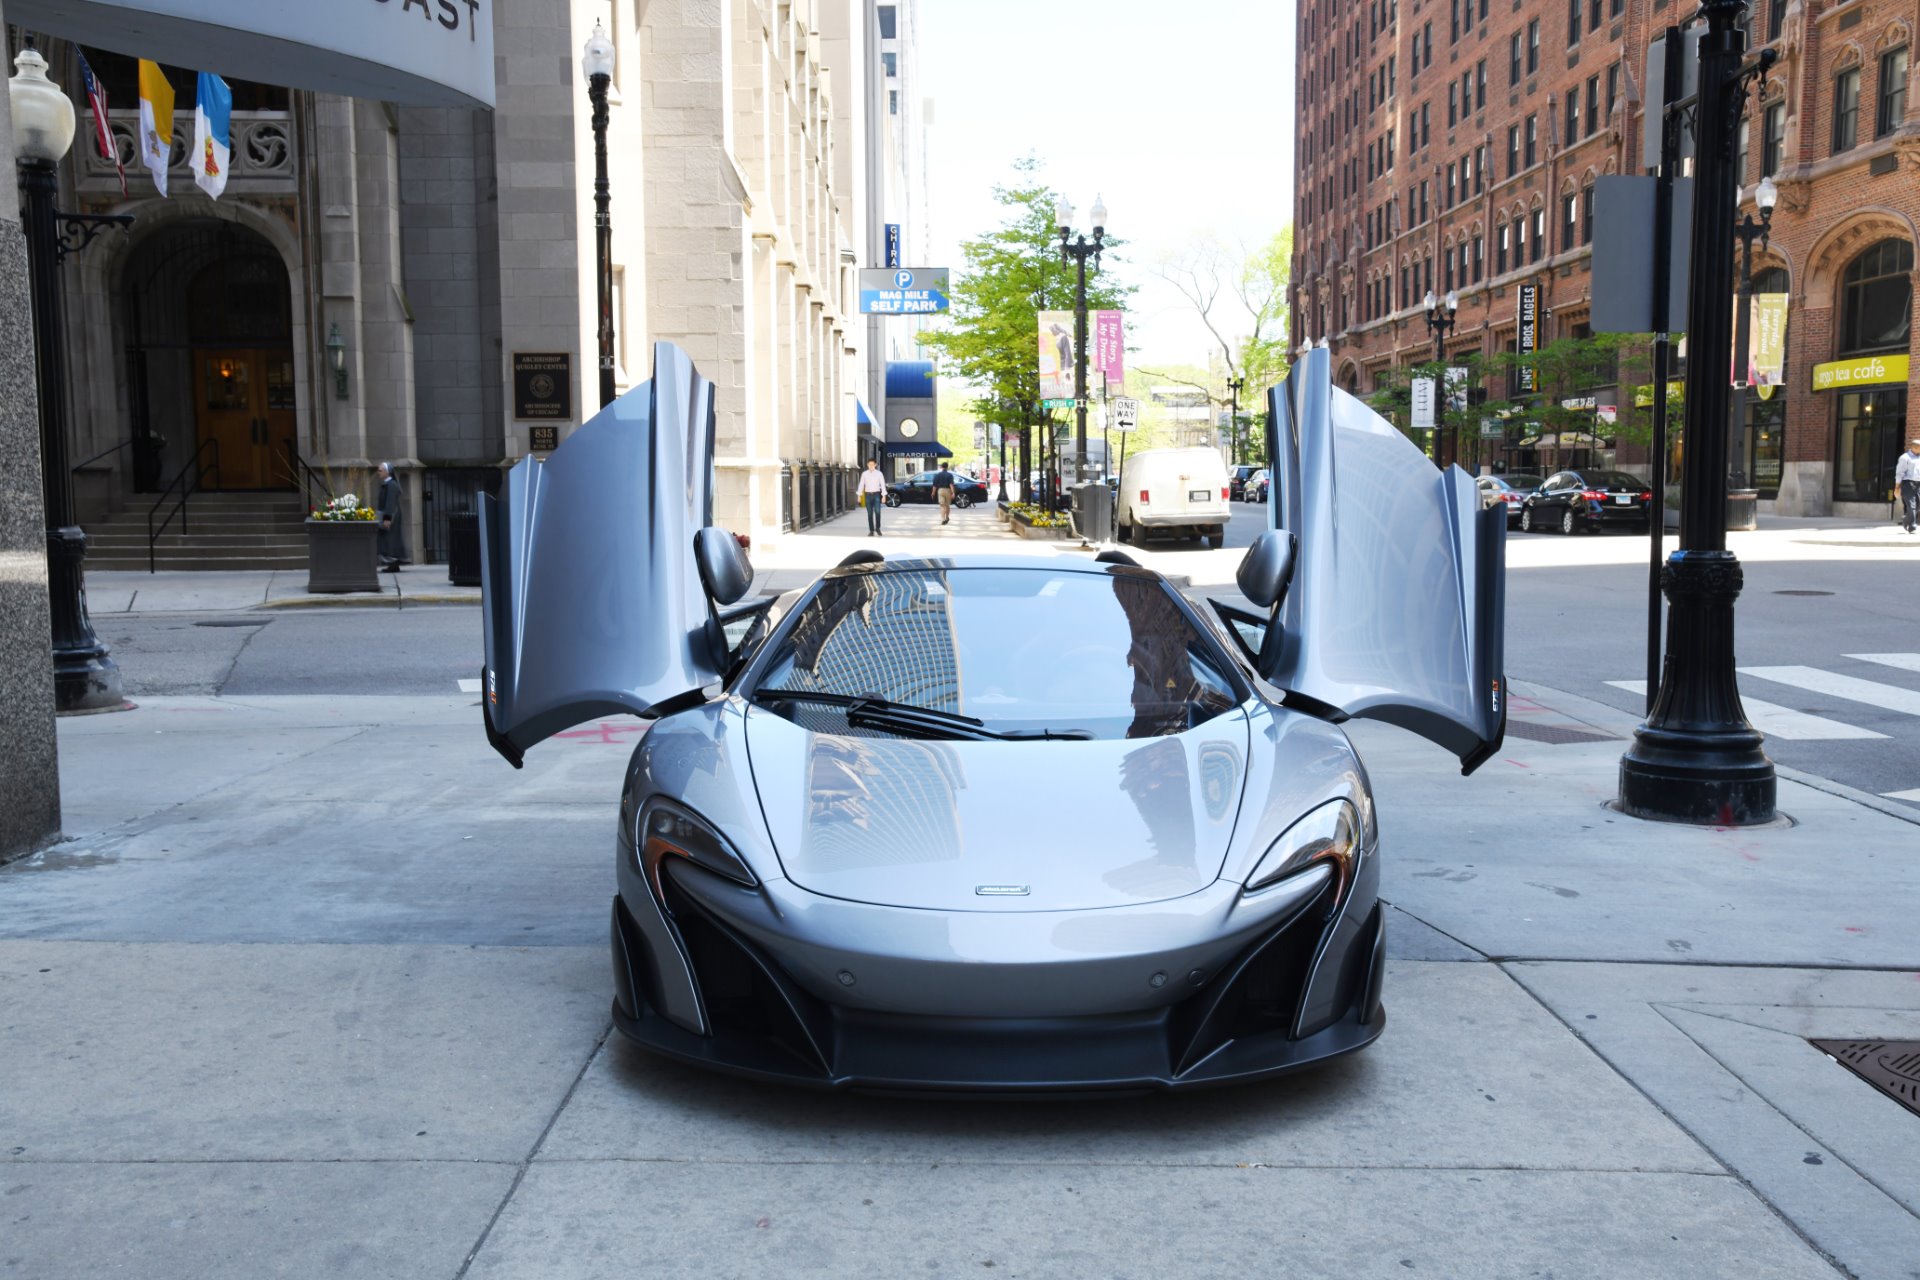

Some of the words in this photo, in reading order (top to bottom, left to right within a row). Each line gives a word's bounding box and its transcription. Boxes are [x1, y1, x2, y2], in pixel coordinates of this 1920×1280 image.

[890, 226, 898, 268] GHIRA
[879, 290, 902, 300] MAG
[904, 290, 929, 300] MILE
[870, 300, 901, 311] SELF
[903, 300, 938, 311] PARK
[1523, 287, 1535, 321] BAGELS
[1098, 322, 1108, 336] My
[1109, 322, 1118, 337] Her
[1836, 368, 1850, 381] tea
[1854, 358, 1885, 379] café
[1049, 399, 1067, 408] RUSH
[1117, 401, 1135, 410] ONE
[1117, 410, 1135, 418] WAY
[534, 428, 553, 438] 835
